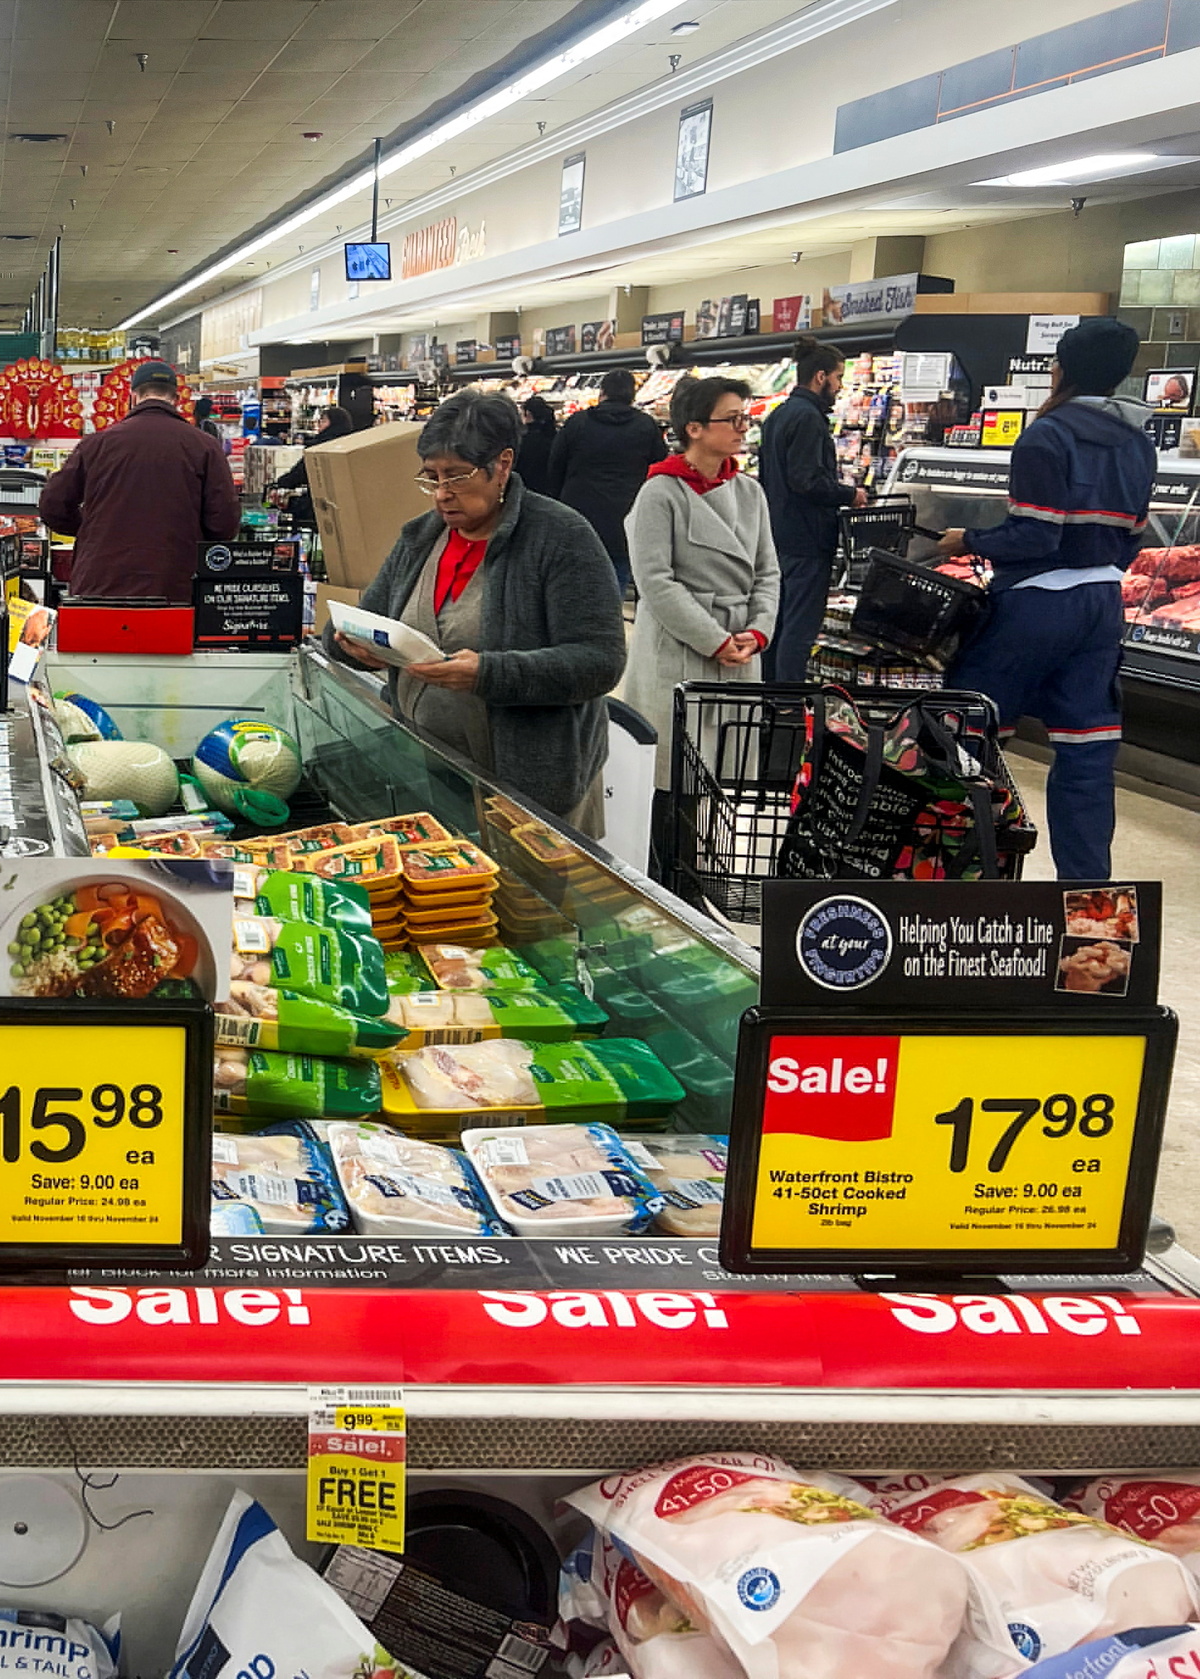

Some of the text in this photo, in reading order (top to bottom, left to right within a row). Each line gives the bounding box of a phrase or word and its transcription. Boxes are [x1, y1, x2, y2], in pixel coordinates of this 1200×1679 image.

[804, 904, 885, 939] FRESHNESS
[900, 912, 1053, 952] Helping You Catch a Line
[821, 934, 871, 956] at your
[904, 949, 1047, 977] on the Finest Seafood!
[767, 1057, 888, 1094] Sale!
[126, 1150, 155, 1166] ea
[1072, 1158, 1101, 1174] ea
[31, 1174, 140, 1190] Save: 9.00 ea
[769, 1170, 914, 1184] Waterfront Bistro
[773, 1186, 907, 1200] 41-50ct Cooked
[974, 1183, 1082, 1198] Save: 9.00 ea
[24, 1196, 147, 1208] Regular Price: 24.98 ea
[808, 1202, 867, 1218] Shrimp
[964, 1205, 1005, 1216] Regular
[1008, 1205, 1038, 1215] Price:
[11, 1214, 31, 1223] Valid
[33, 1214, 74, 1222] November
[106, 1215, 147, 1223] November
[950, 1222, 970, 1230] Valid
[971, 1222, 1013, 1230] November
[1044, 1222, 1085, 1230] November
[230, 1245, 407, 1264] SIGNATURE
[413, 1245, 511, 1264] ITEMS.
[555, 1246, 685, 1265] WE PRIDE
[69, 1286, 310, 1326] Sale!
[483, 1290, 728, 1329] Sale!
[877, 1291, 1142, 1335] Sale!
[326, 1437, 386, 1455] Sale!
[329, 1466, 349, 1477] Buy
[358, 1466, 378, 1478] Get
[319, 1477, 397, 1511] FREE
[662, 1472, 734, 1513] 41-50
[15, 1657, 29, 1669] &
[32, 1658, 70, 1678] TAIL
